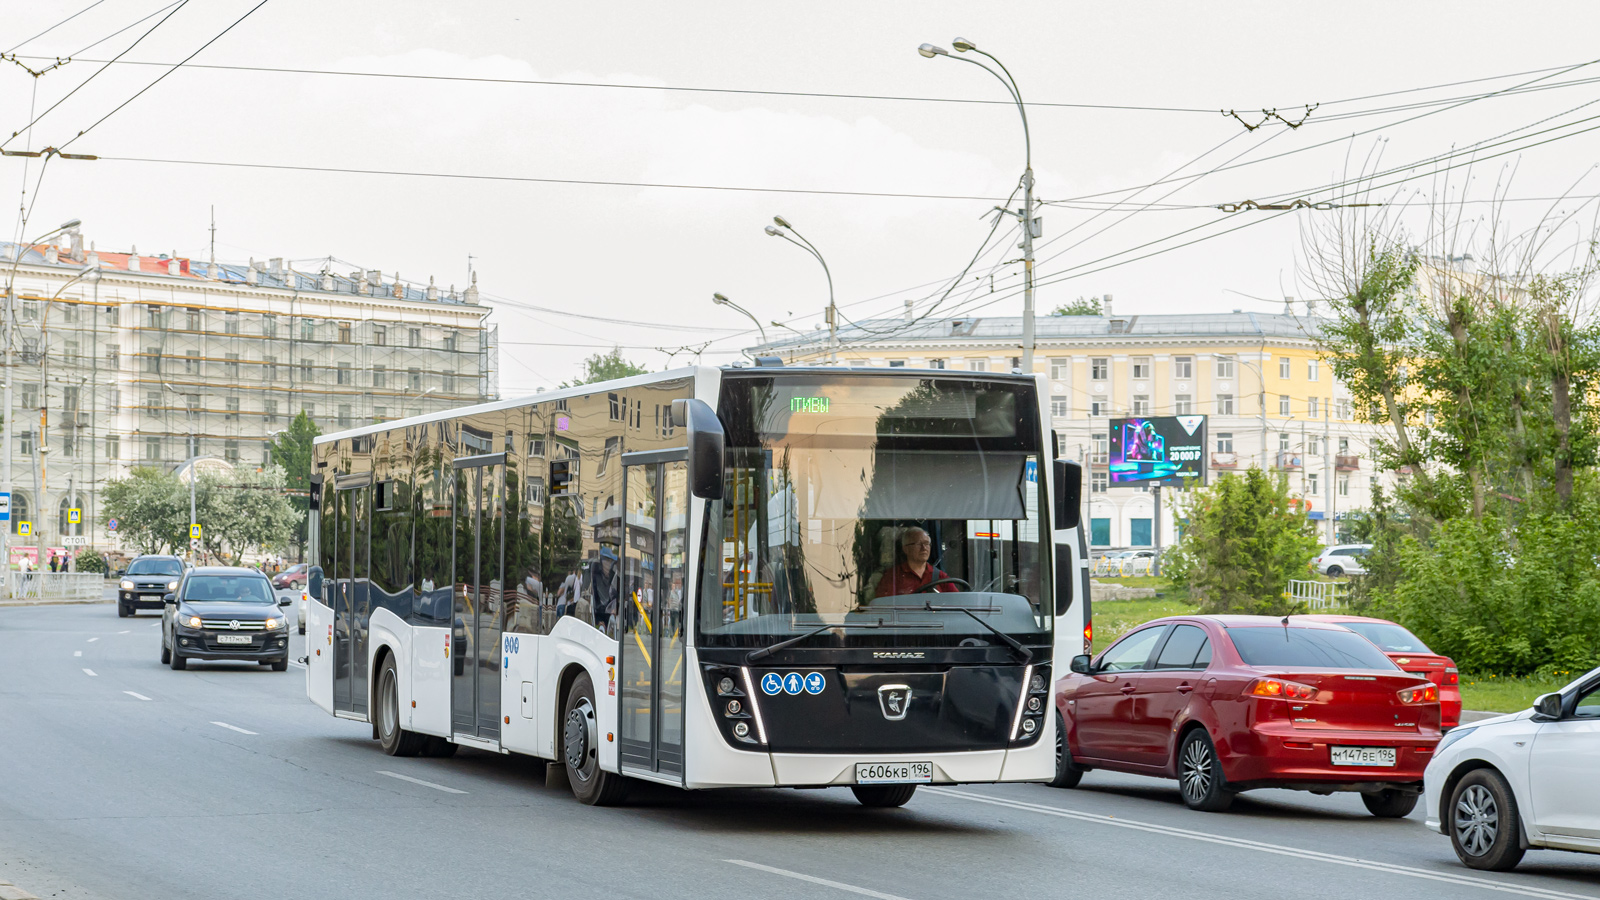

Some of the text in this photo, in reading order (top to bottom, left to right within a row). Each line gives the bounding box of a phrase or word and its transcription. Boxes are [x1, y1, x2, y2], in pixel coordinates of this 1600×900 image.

[1170, 451, 1179, 461] 20
[1180, 451, 1194, 461] 000
[872, 651, 925, 659] KAMAZ
[1334, 749, 1393, 762] М147ВЕ 196
[860, 764, 929, 778] С606КВ 196
